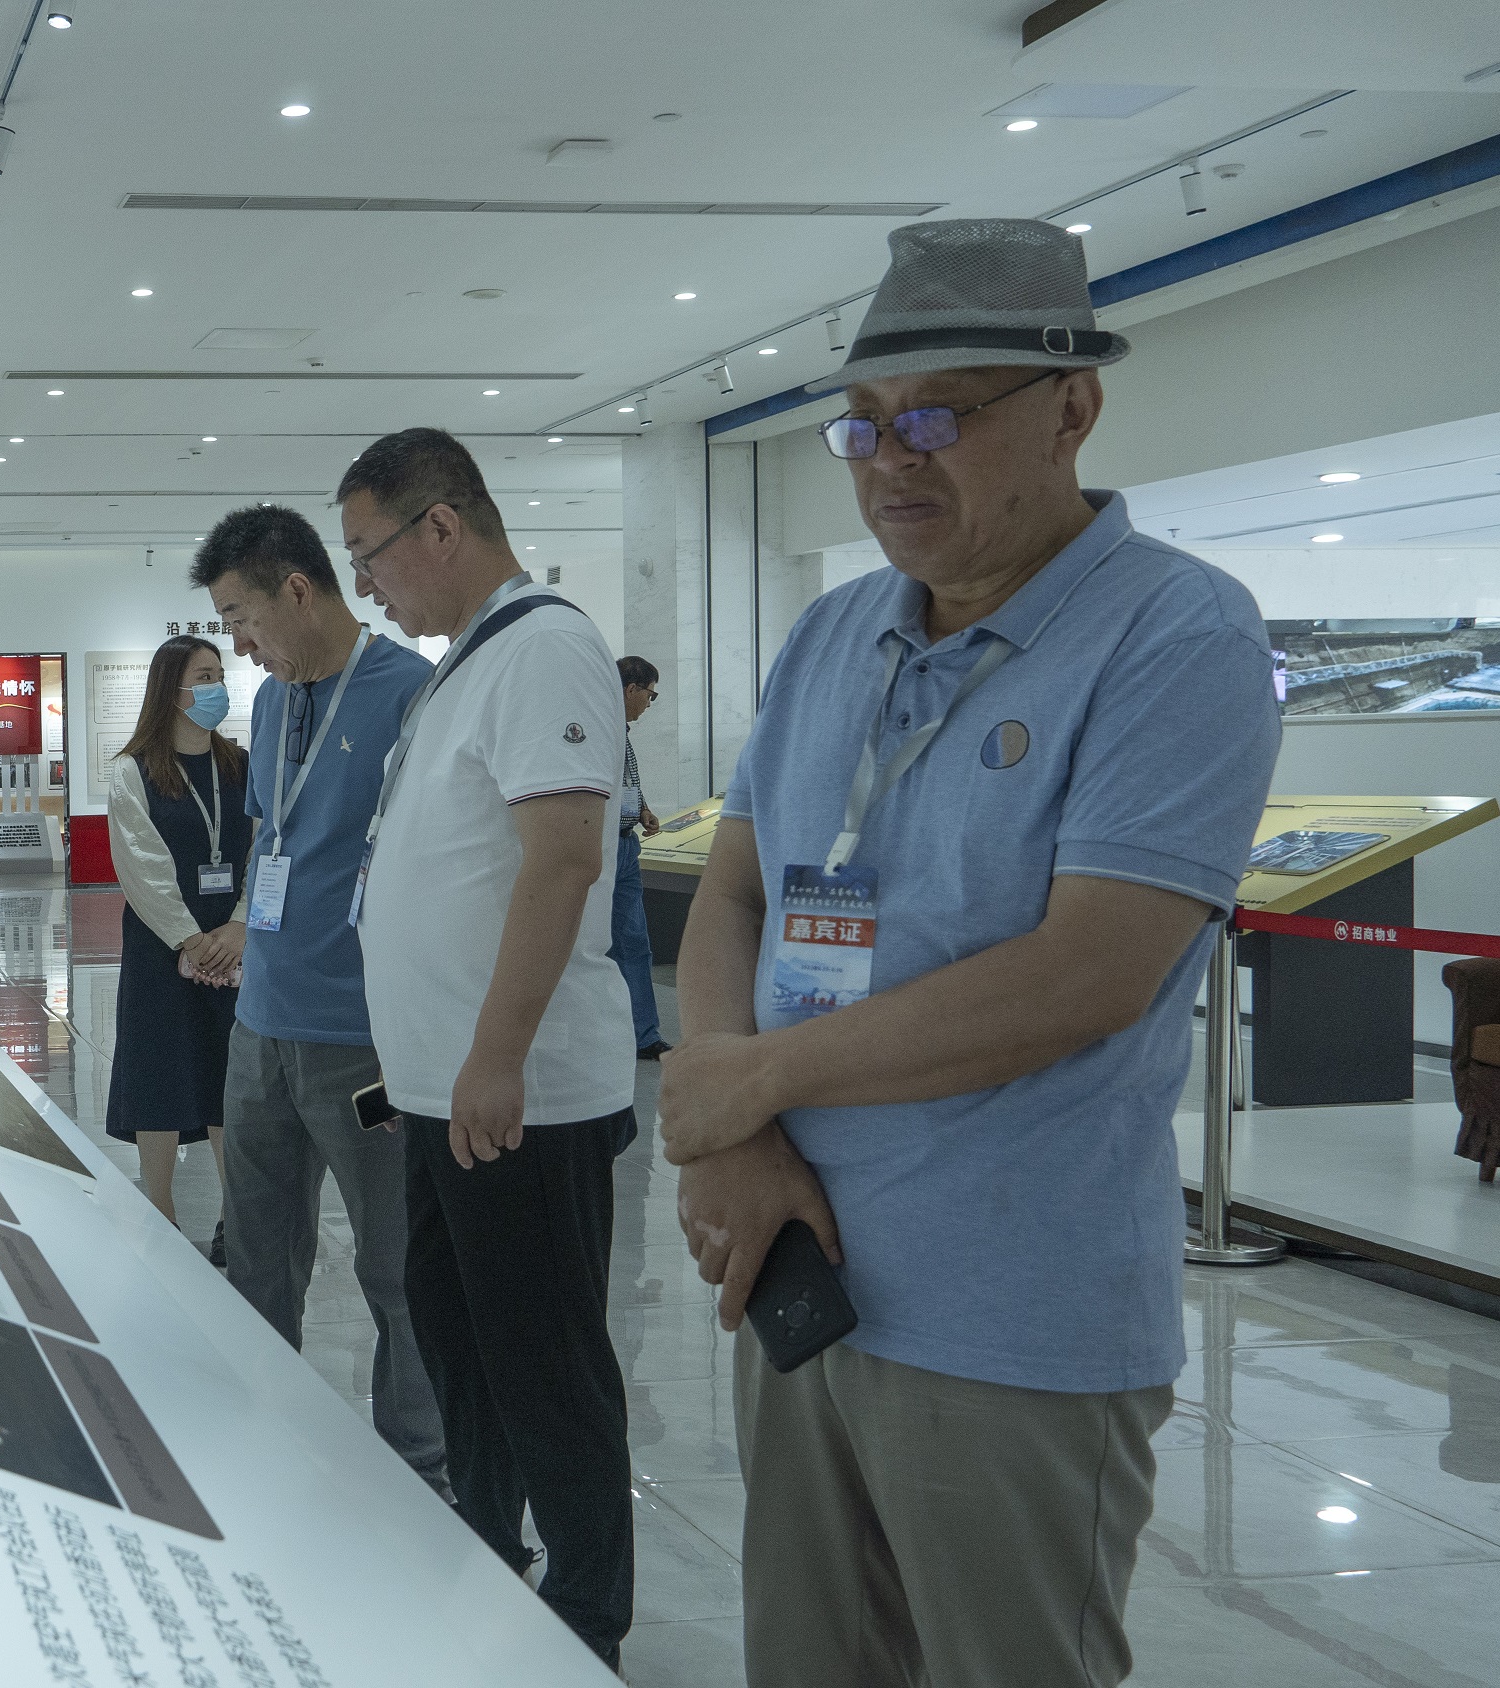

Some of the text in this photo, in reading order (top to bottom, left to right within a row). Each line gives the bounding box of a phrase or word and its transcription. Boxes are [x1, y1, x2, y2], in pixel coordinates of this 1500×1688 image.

[789, 918, 862, 942] 嘉宾证
[1352, 925, 1398, 942] 招商物业
